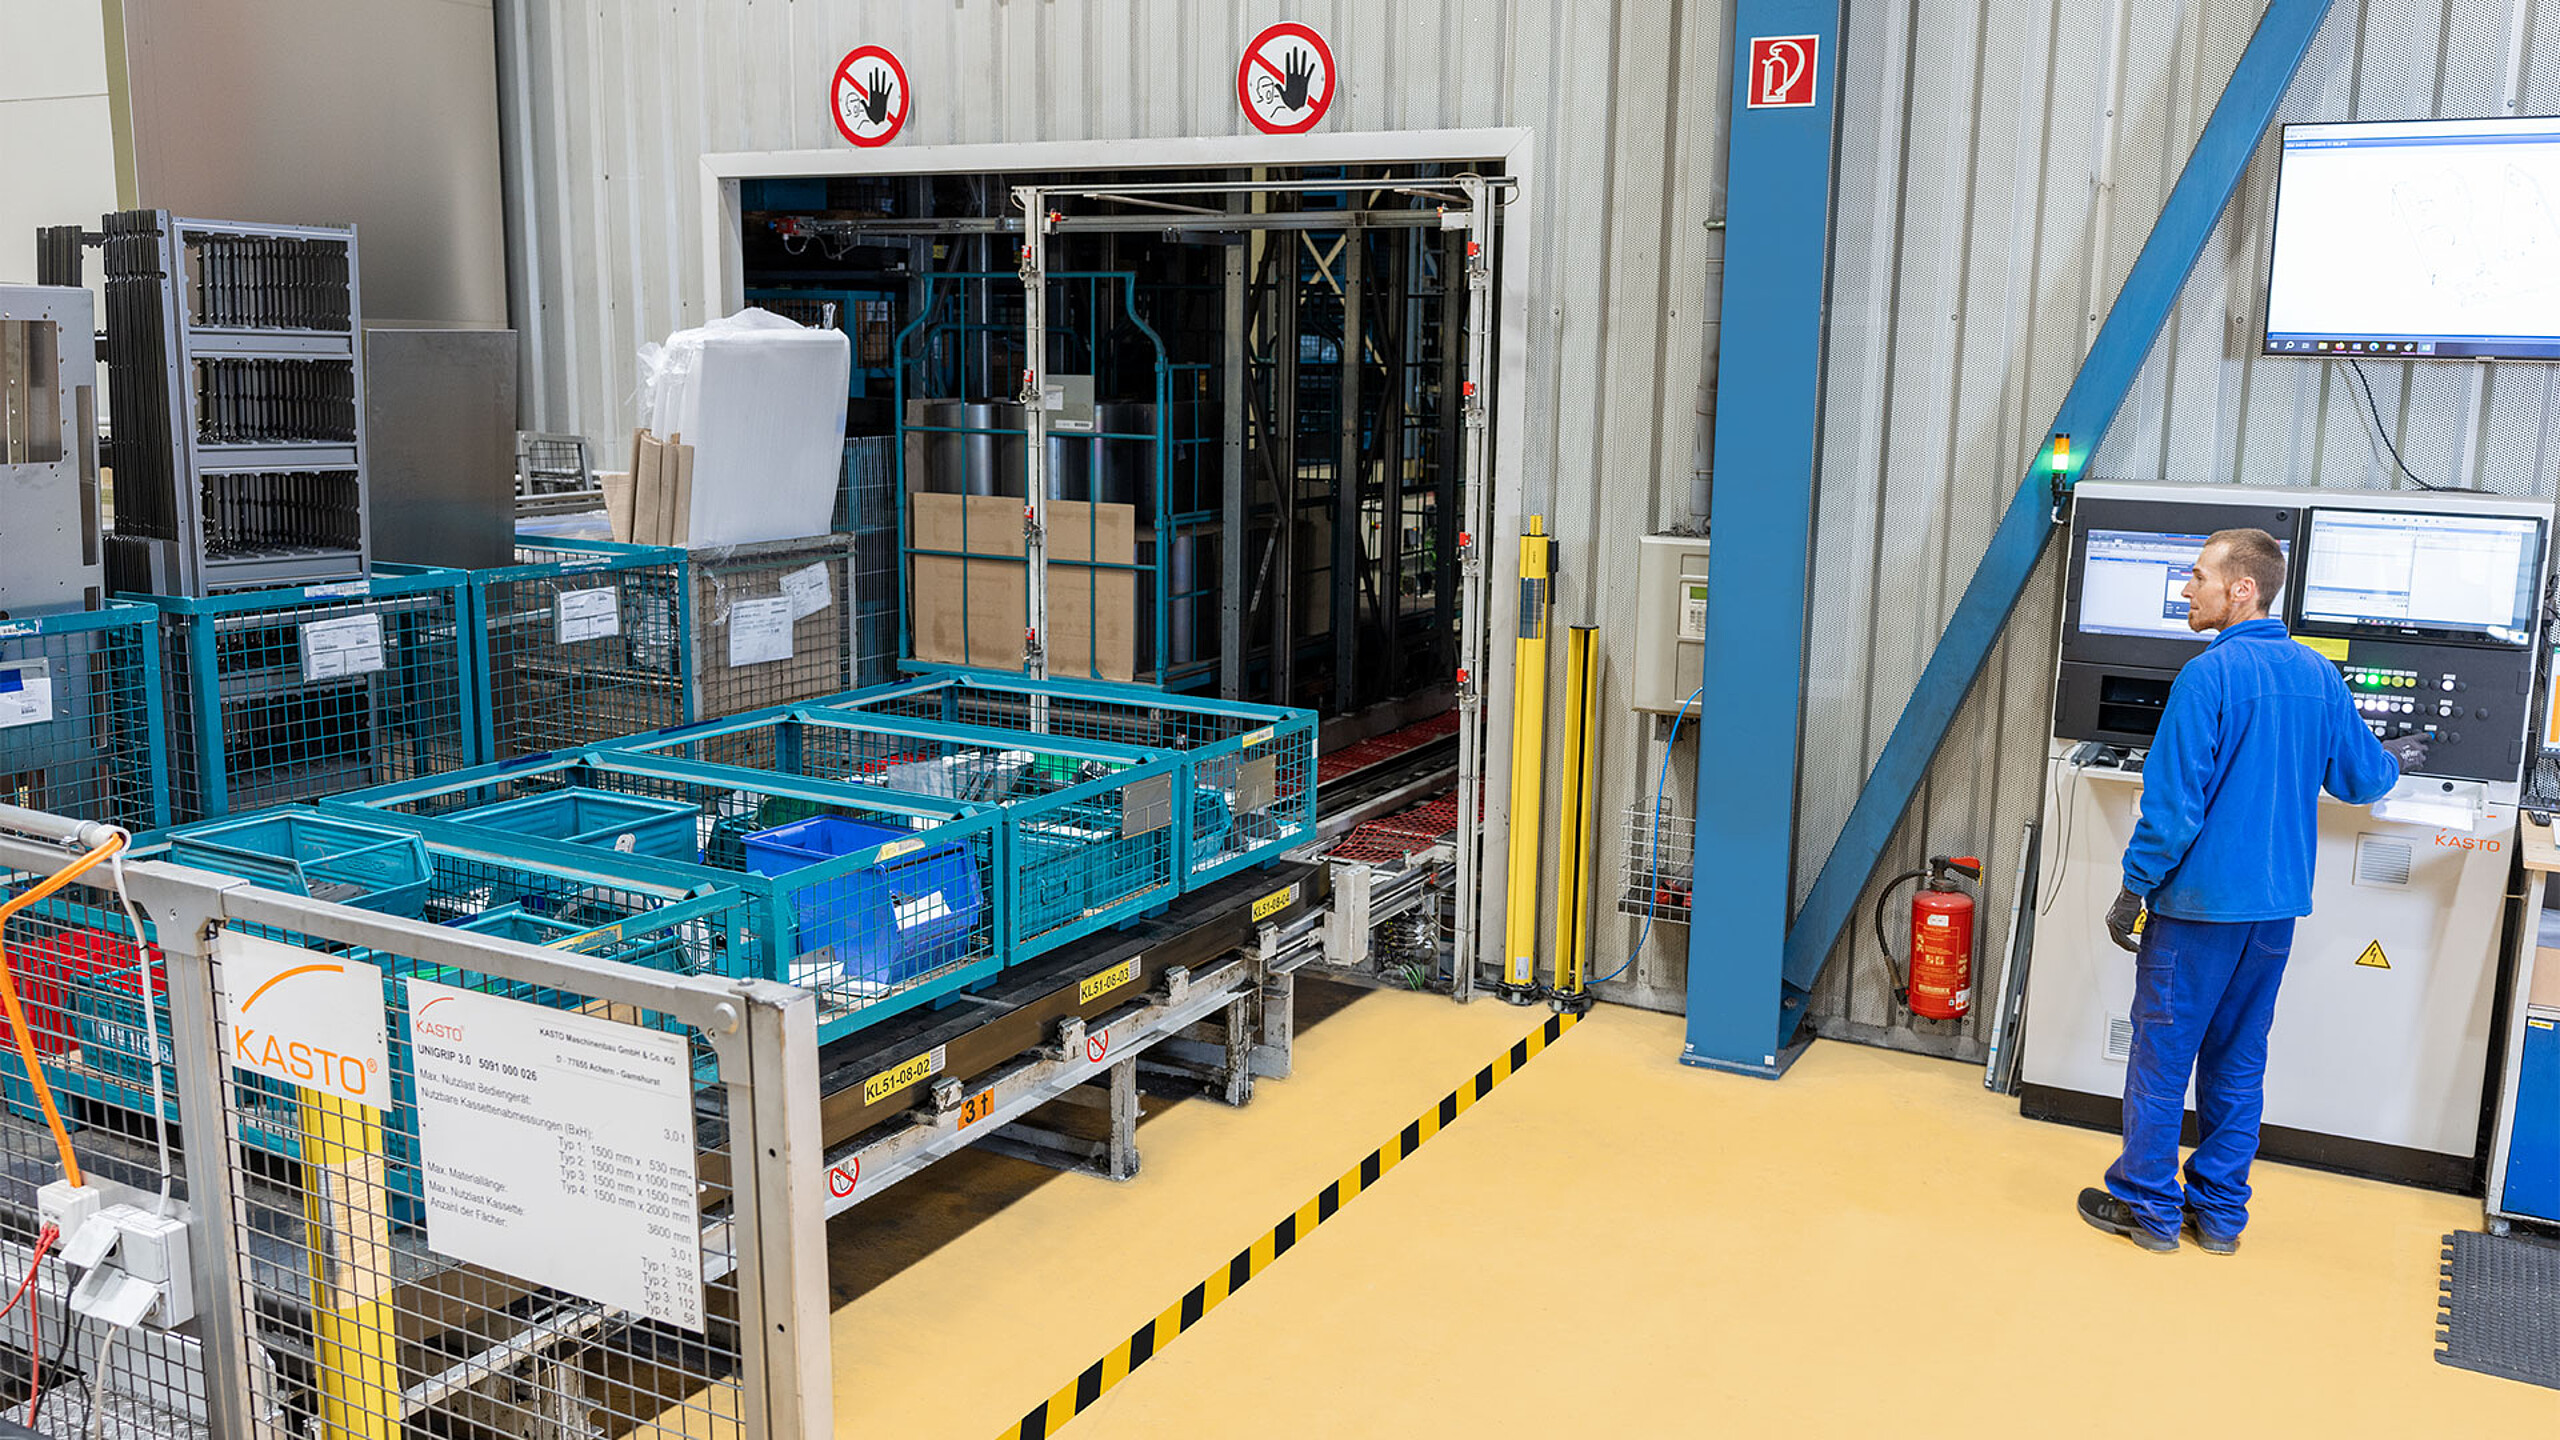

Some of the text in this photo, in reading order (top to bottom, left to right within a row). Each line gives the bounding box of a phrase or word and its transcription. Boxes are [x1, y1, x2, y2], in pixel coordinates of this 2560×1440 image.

[2434, 834, 2502, 853] KASTO
[1253, 892, 1290, 919] KL51-08-04
[1081, 967, 1130, 1001] KL51-08-03
[539, 1027, 565, 1040] KASTO
[566, 1034, 617, 1053] Maschinenbau
[618, 1045, 641, 1058] GmbH
[642, 1051, 649, 1060] &
[663, 1056, 677, 1066] KG
[417, 1044, 456, 1062] UNIGRIP
[479, 1058, 499, 1072] 5091
[502, 1063, 518, 1077] 000
[520, 1068, 538, 1082] 026
[555, 1055, 562, 1063] D
[589, 1063, 616, 1075] Achern
[620, 1069, 661, 1086] Gamshurst
[419, 1068, 440, 1082] Max.
[441, 1073, 476, 1091] Nutzlast
[866, 1058, 930, 1101] KL51-08-02
[420, 1086, 460, 1105] Nutzbare
[460, 1097, 563, 1132] Kassettenabmessungen
[965, 1093, 988, 1125] 3 t
[427, 1161, 447, 1176] Max.
[558, 1136, 575, 1152] Typ
[591, 1144, 614, 1160] 1500
[615, 1153, 633, 1165] mm
[649, 1159, 668, 1174] 530
[669, 1166, 688, 1178] mm
[559, 1150, 576, 1166] Typ
[592, 1159, 615, 1175] 1500
[616, 1167, 634, 1180] mm
[645, 1173, 669, 1189] 1000
[670, 1182, 689, 1194] mm
[428, 1180, 449, 1195] Max.
[450, 1186, 485, 1205] Nutzlast
[560, 1165, 577, 1181] Typ
[593, 1174, 615, 1190] 1500
[617, 1182, 635, 1195] mm
[646, 1187, 670, 1204] 1500
[671, 1196, 690, 1209] mm
[430, 1196, 458, 1213] Anzahl
[459, 1205, 474, 1217] der
[561, 1179, 578, 1195] Typ
[594, 1188, 616, 1204] 1500
[618, 1197, 636, 1210] mm
[646, 1202, 670, 1219] 2000
[672, 1211, 691, 1224] mm
[2096, 1203, 2134, 1220] uve
[646, 1223, 692, 1245] 3600 mm
[641, 1256, 659, 1272] Typ
[674, 1266, 694, 1281] 338
[642, 1271, 660, 1286] Typ
[677, 1282, 694, 1295] 174
[643, 1286, 661, 1301] Typ
[678, 1297, 696, 1311] 112
[643, 1300, 661, 1316] Typ
[683, 1311, 696, 1326] 58
